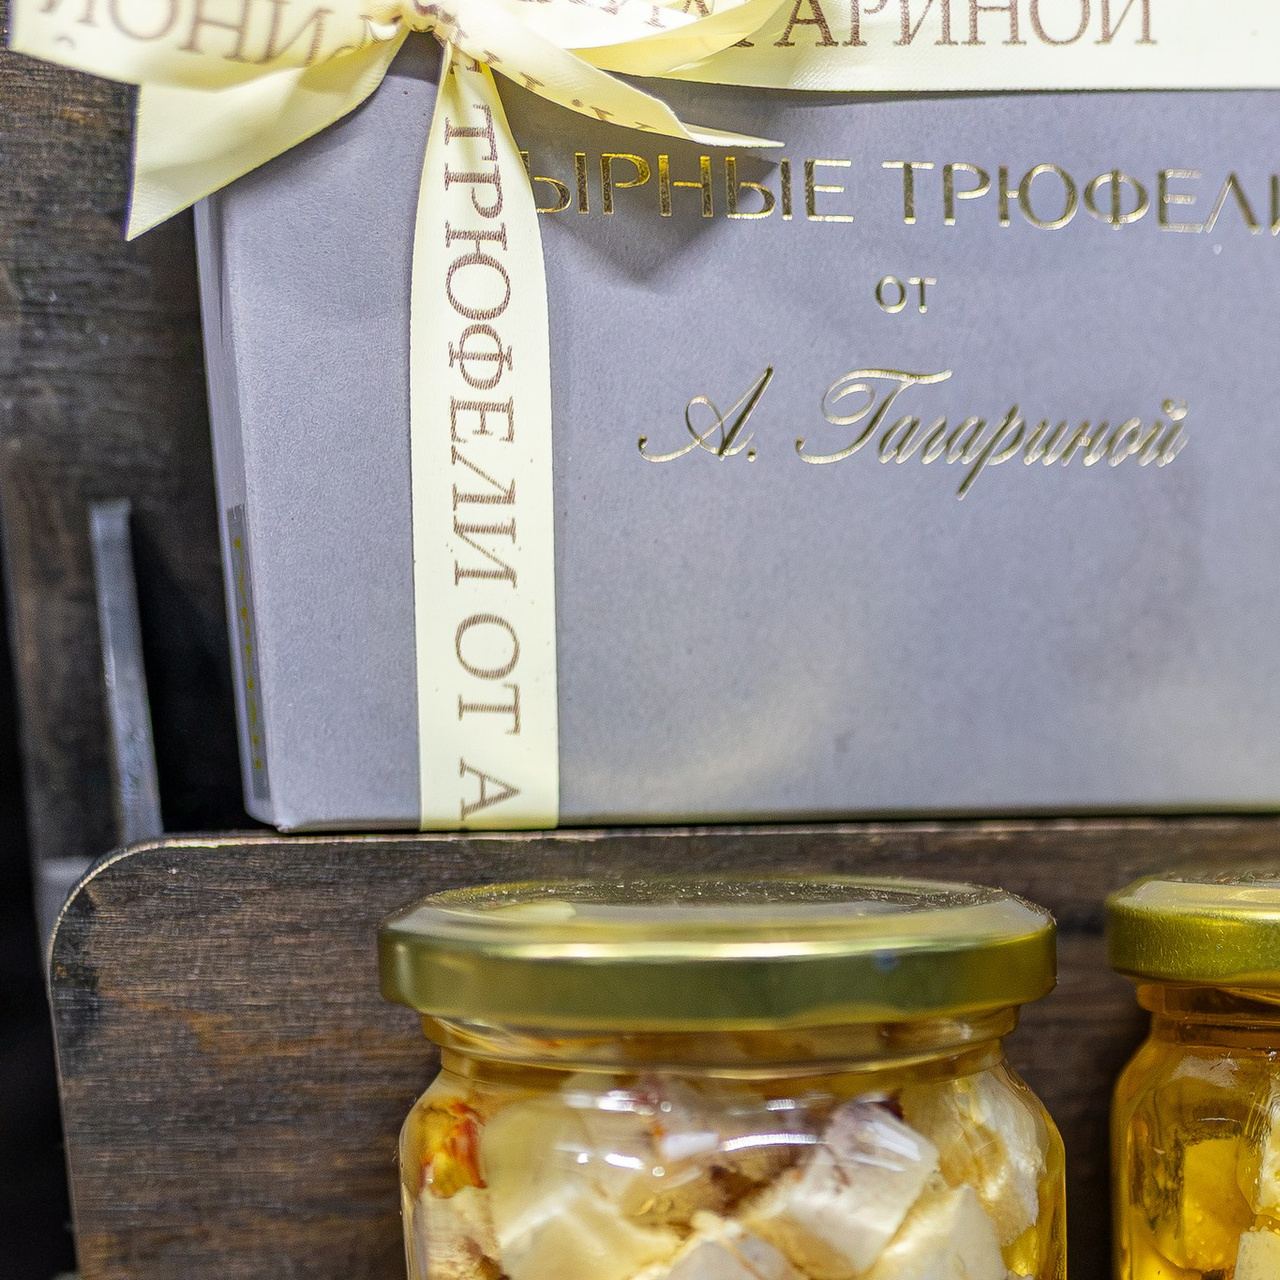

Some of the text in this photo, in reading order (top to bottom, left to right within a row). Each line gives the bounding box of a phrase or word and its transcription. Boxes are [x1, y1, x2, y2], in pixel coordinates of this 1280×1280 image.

[521, 151, 855, 223] ЫРНЫЕ
[444, 103, 518, 588] ТРЮФЕЛИ
[455, 613, 521, 735] ОТ
